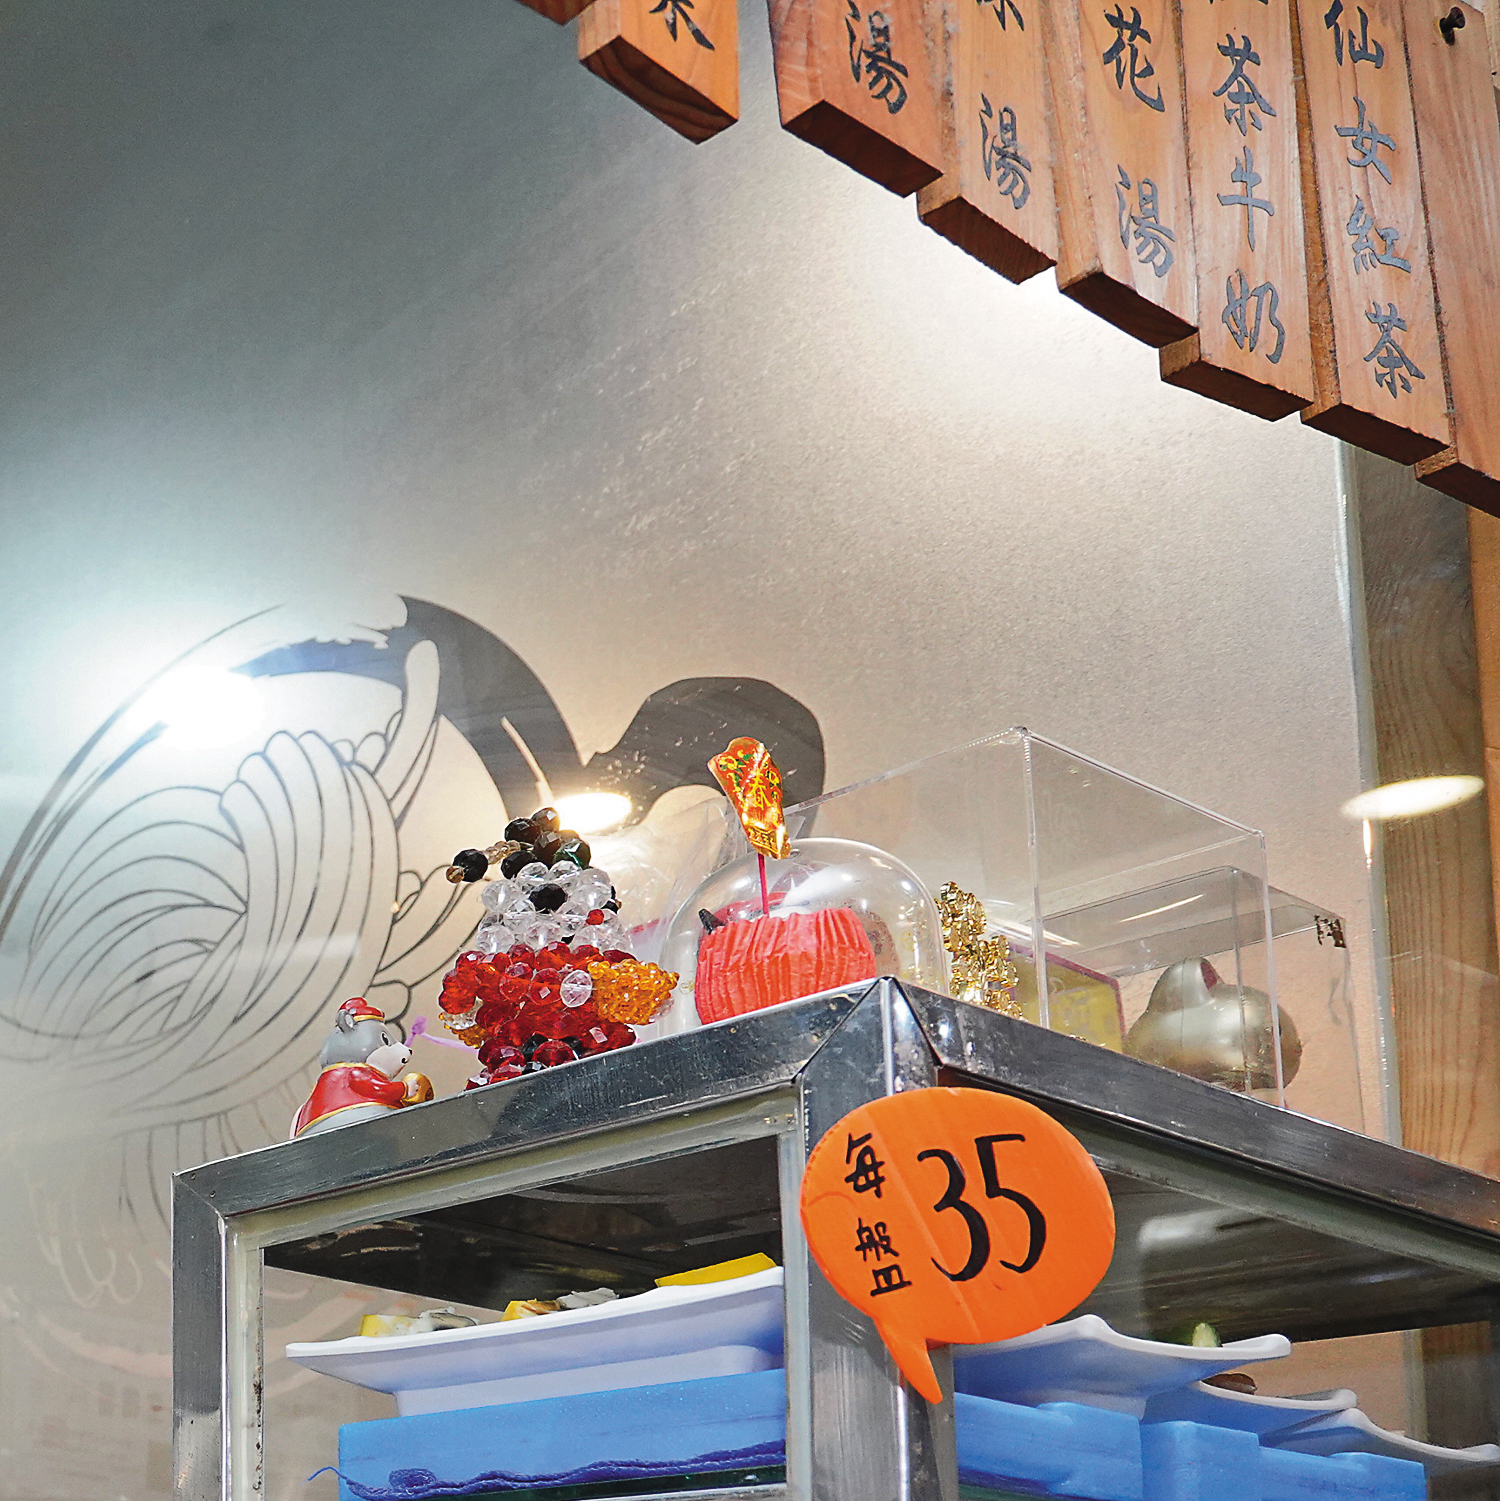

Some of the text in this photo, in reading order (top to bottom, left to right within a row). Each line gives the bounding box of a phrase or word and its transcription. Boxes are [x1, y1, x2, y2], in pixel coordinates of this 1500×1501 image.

[1102, 2, 1176, 278] 花湯
[1213, 33, 1287, 364] 茶牛奶
[1323, 0, 1426, 399] 仙女紅茶
[917, 1133, 1047, 1282] 35
